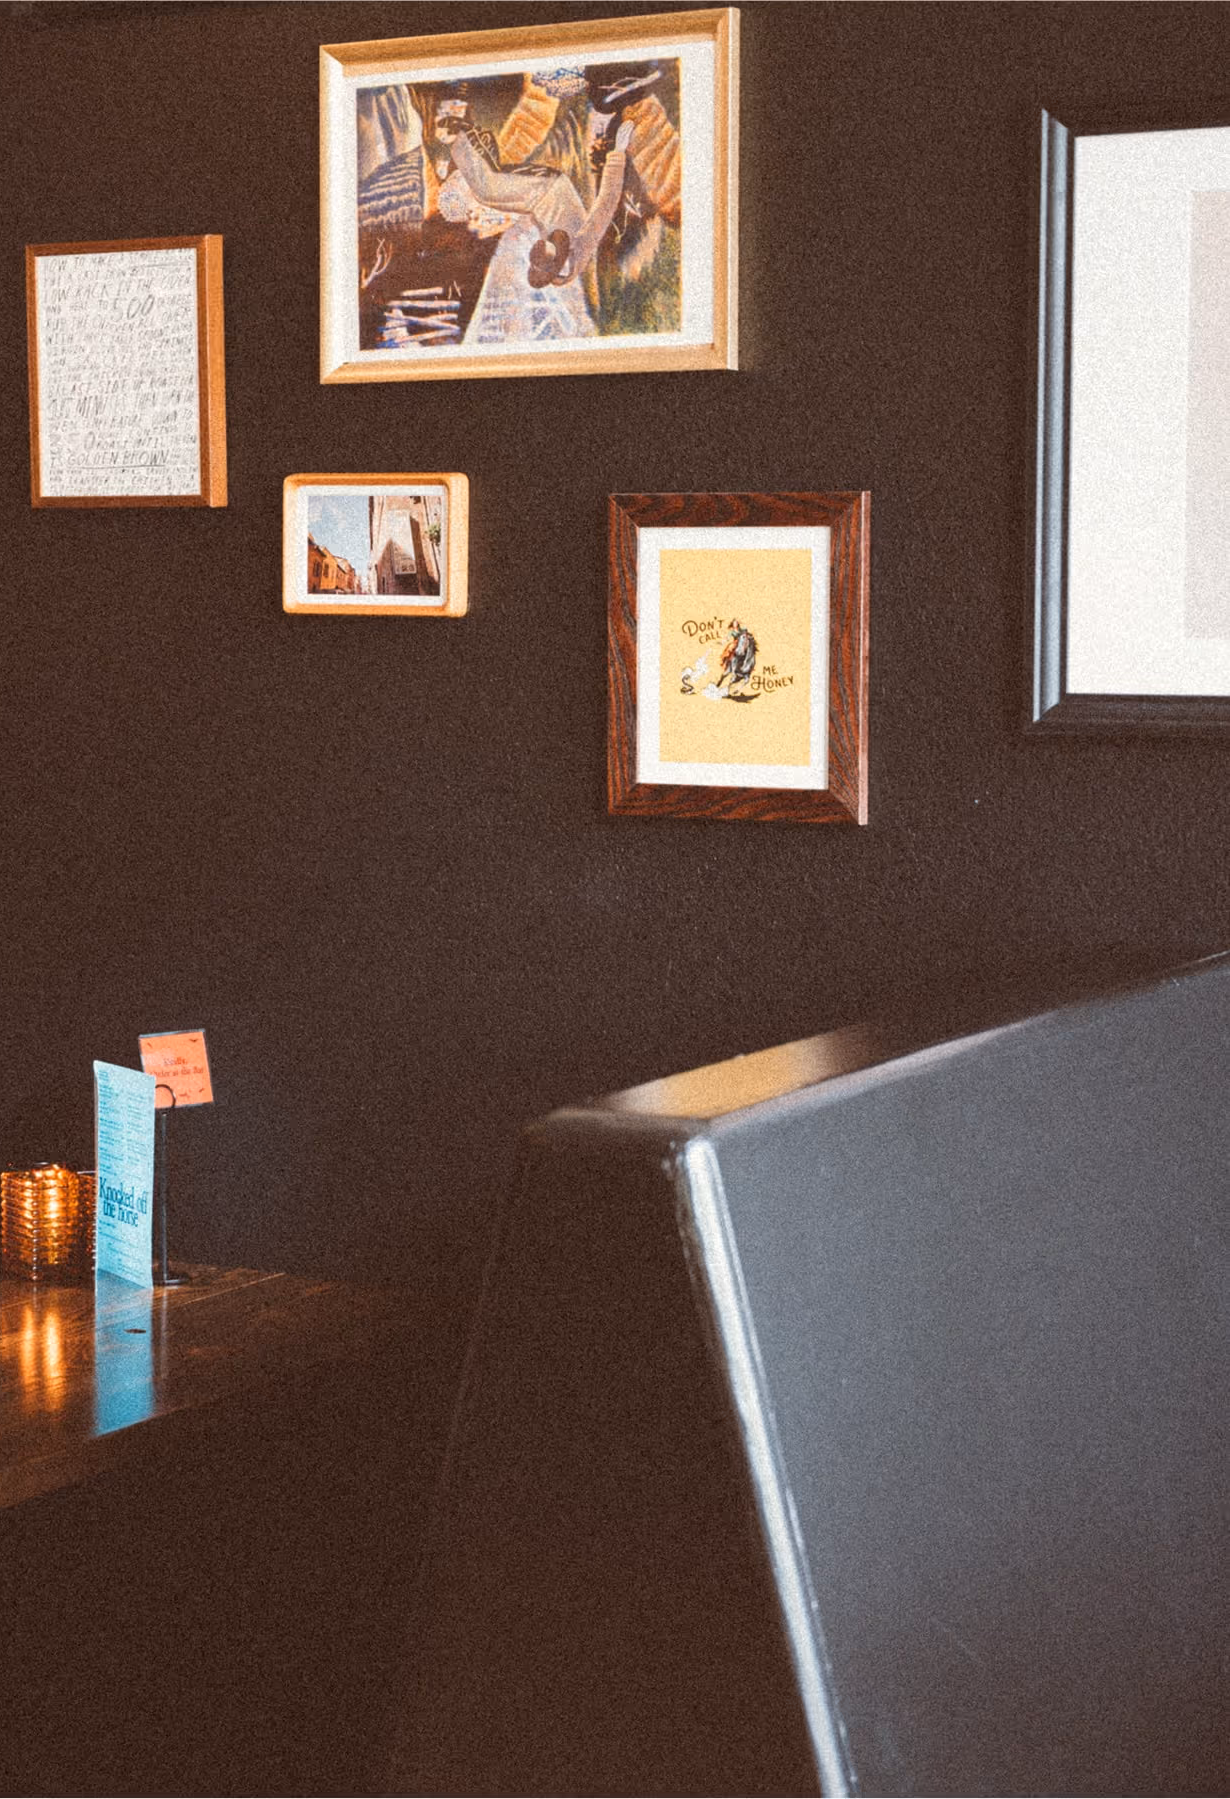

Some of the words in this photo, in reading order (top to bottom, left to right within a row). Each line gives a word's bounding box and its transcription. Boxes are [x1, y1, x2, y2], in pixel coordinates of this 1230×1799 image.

[110, 293, 156, 323] 500
[66, 450, 120, 467] GOLDEN
[122, 448, 171, 466] BROWN
[682, 616, 724, 637] DON'T
[698, 631, 722, 645] CALL
[762, 664, 779, 675] ME
[750, 675, 795, 693] HONEY
[99, 1176, 135, 1210] Knocked
[136, 1190, 149, 1215] off
[103, 1199, 116, 1219] the
